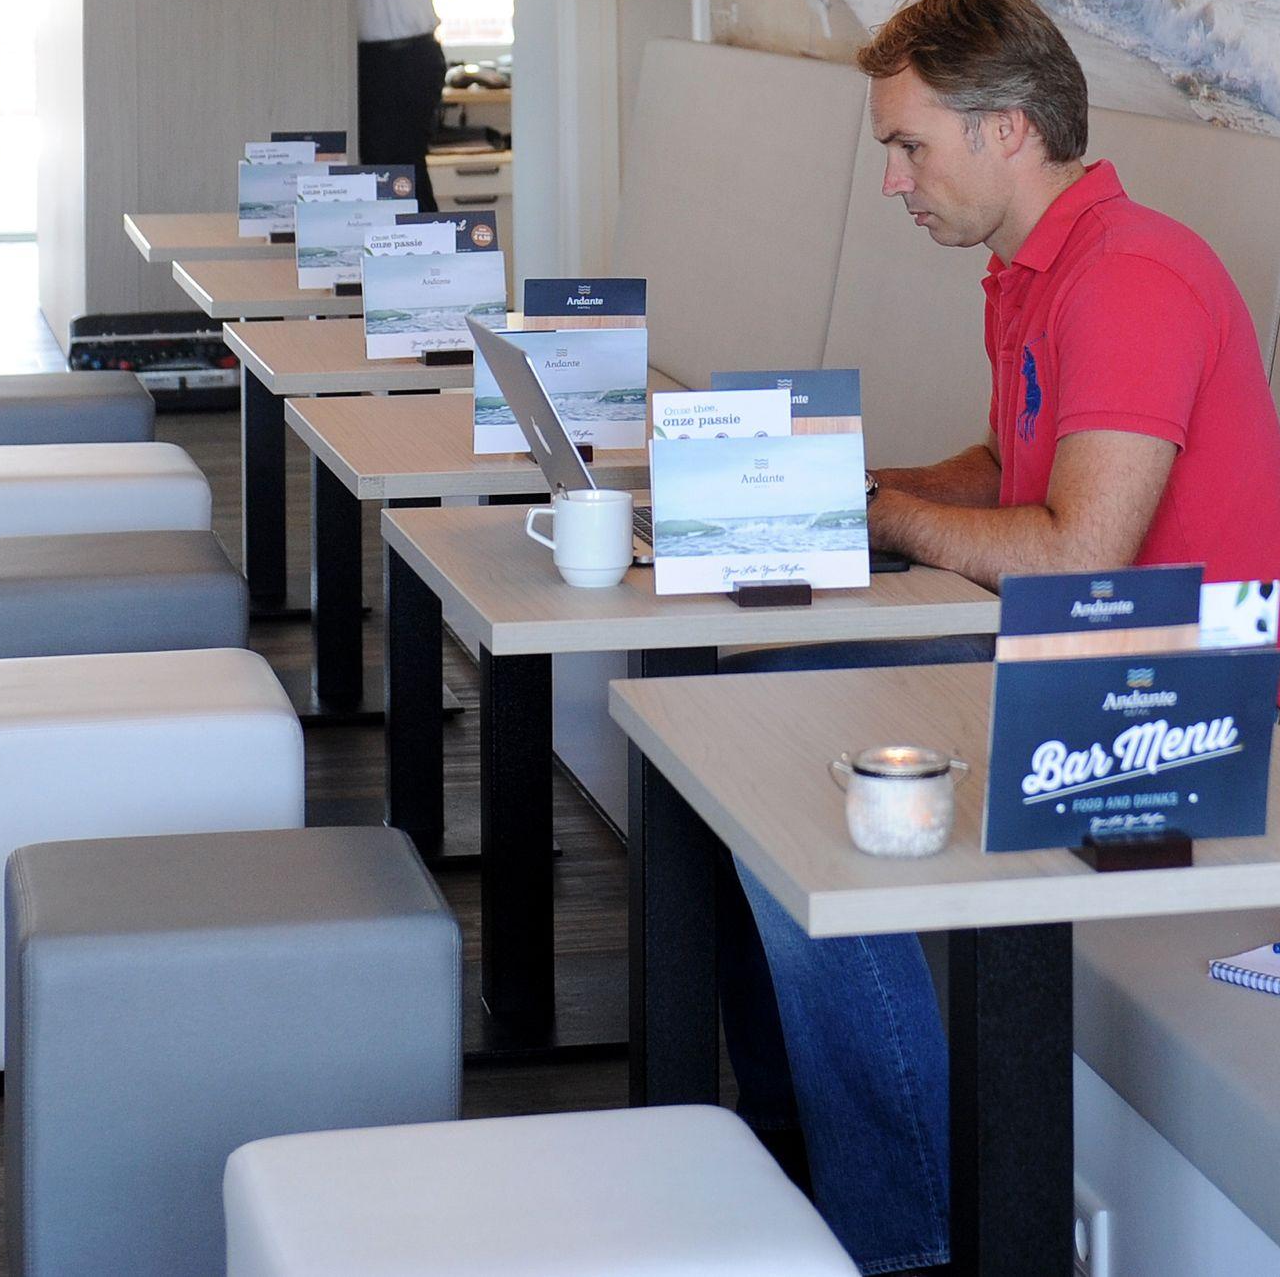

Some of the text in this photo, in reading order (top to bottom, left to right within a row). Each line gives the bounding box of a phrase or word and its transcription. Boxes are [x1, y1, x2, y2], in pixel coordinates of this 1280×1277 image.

[370, 238, 423, 250] onze passie
[566, 296, 604, 306] Andante
[544, 359, 581, 369] Andante
[662, 412, 742, 429] onze passie
[740, 472, 785, 485] Andante
[1070, 599, 1135, 618] Andante
[1101, 688, 1178, 711] Andante
[1021, 715, 1239, 796] Bar Menu
[1072, 790, 1179, 813] FOOD AND DRINKS
